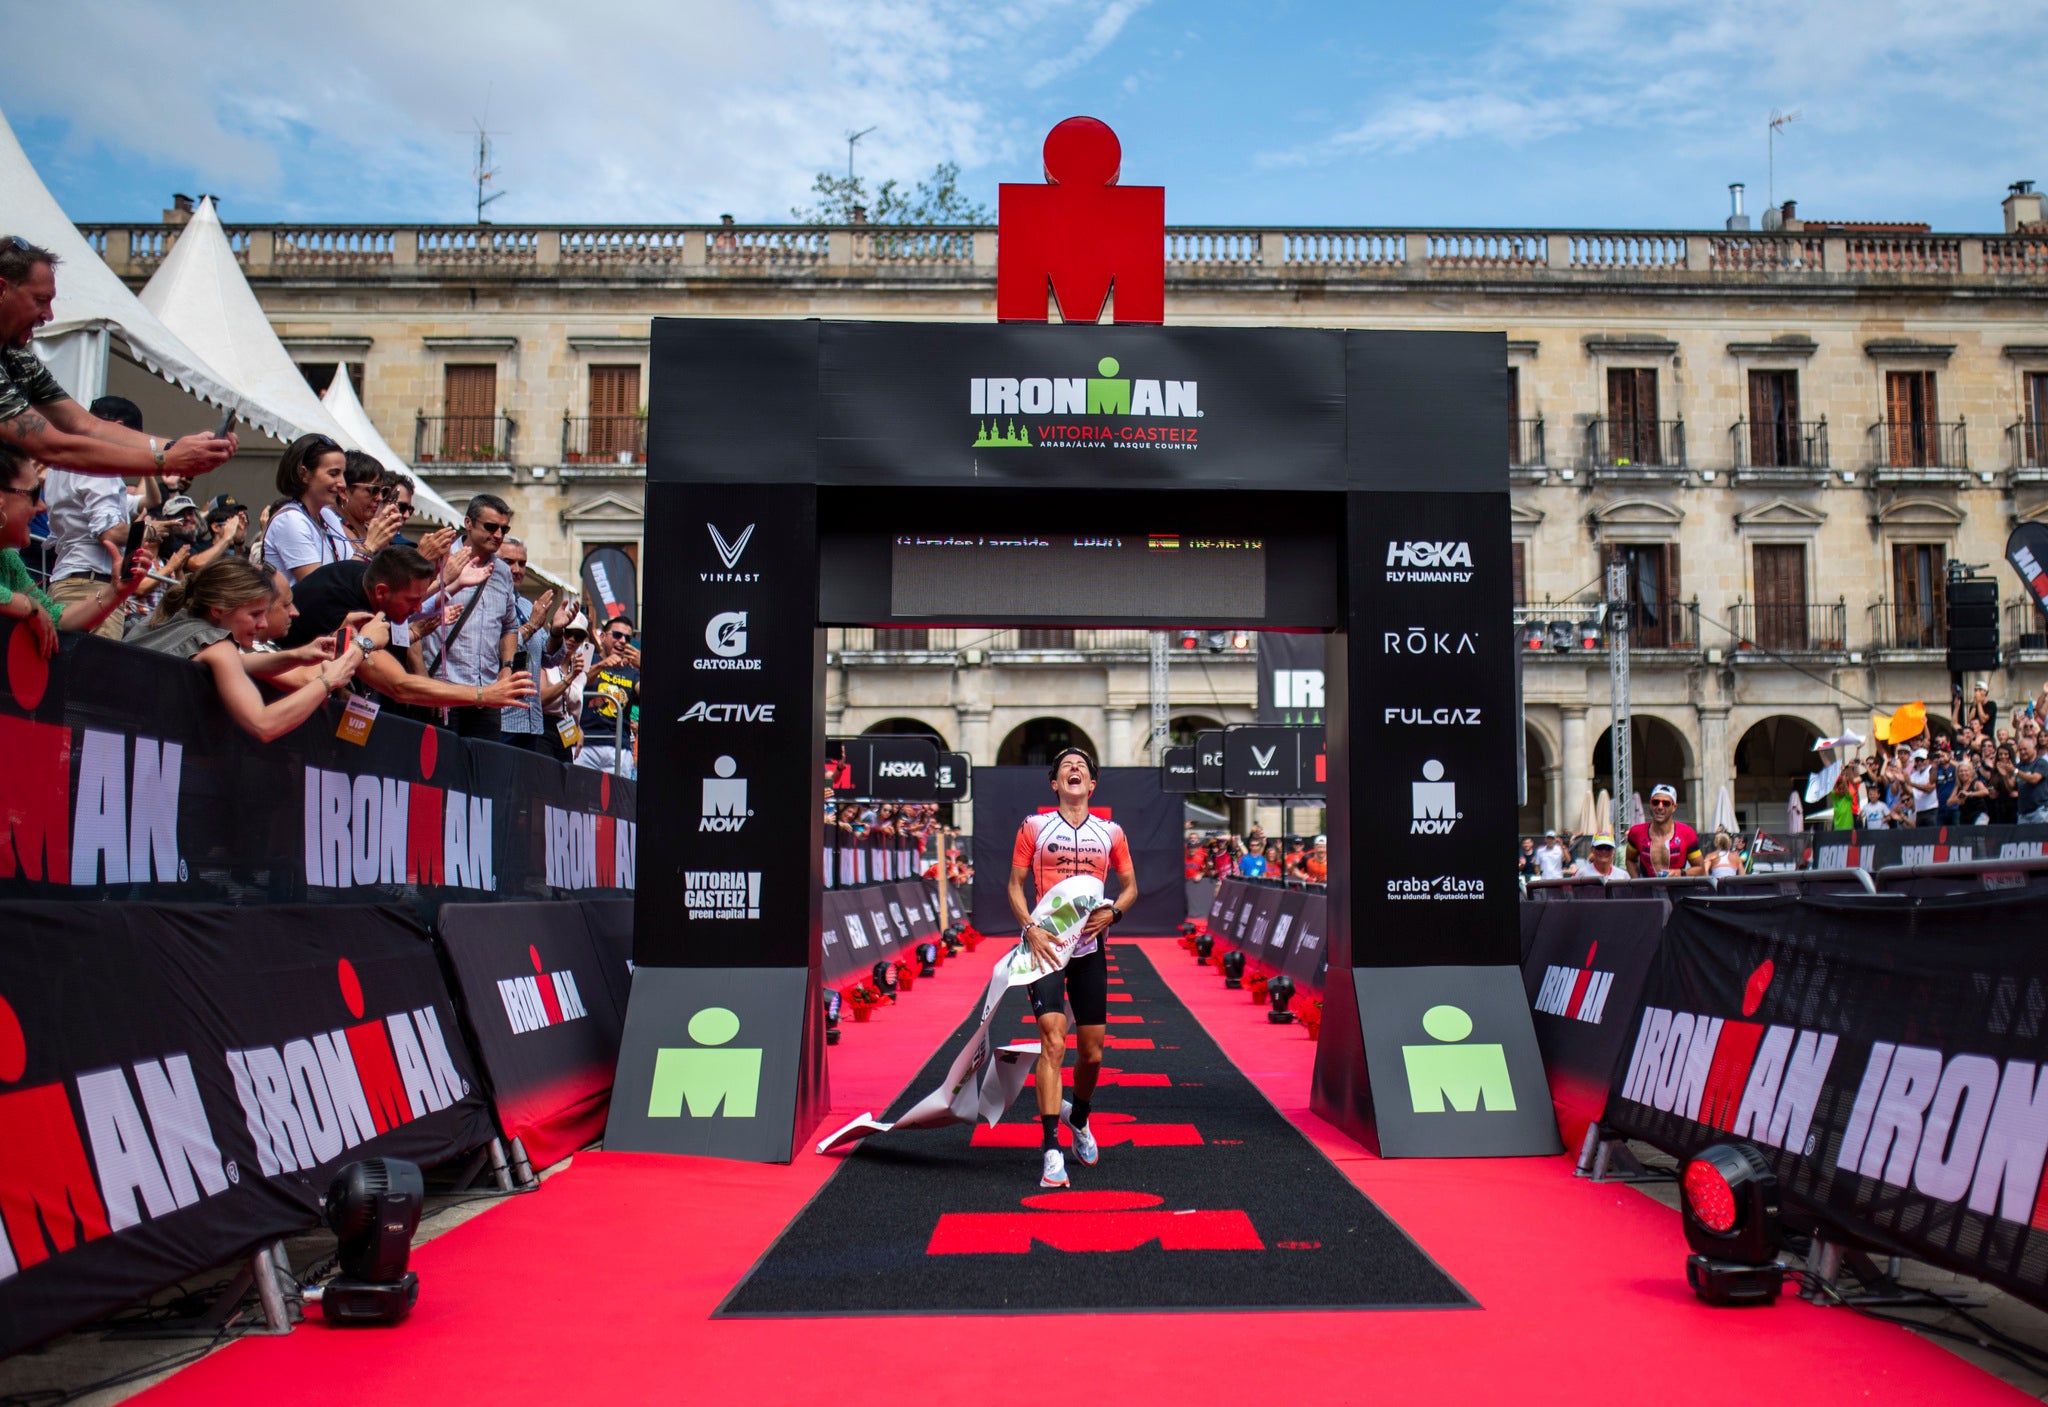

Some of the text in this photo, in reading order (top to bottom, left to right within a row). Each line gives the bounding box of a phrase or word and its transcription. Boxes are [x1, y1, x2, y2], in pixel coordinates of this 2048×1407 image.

[970, 377, 1198, 418] IRONMAN
[1038, 425, 1198, 442] VITORIA-GASTEIZ
[1040, 441, 1106, 449] ARABA/ÁLAVA
[1113, 442, 1151, 450] BASQUE
[1386, 541, 1473, 568] HOKA
[700, 574, 760, 583] VINFAST
[1386, 572, 1473, 583] FLY HUMAN FLY
[693, 659, 762, 670] GATORADE
[677, 701, 776, 722] ACTIVE
[1385, 708, 1482, 725] FULGAZ
[349, 717, 367, 730] VIP
[879, 761, 926, 777] HOKA
[304, 766, 493, 891] IRONMAN
[699, 818, 746, 832] NOW
[1410, 820, 1456, 834] NOW
[684, 872, 747, 889] VITORIA
[1387, 876, 1484, 892] araba álava
[1434, 893, 1468, 901] diputación
[689, 908, 746, 920] green capital
[496, 970, 586, 1034] IRONMAN
[1534, 965, 1615, 1024] IRONMAN
[1621, 1006, 1839, 1154] IRONMAN
[226, 1005, 465, 1178] IRONMAN
